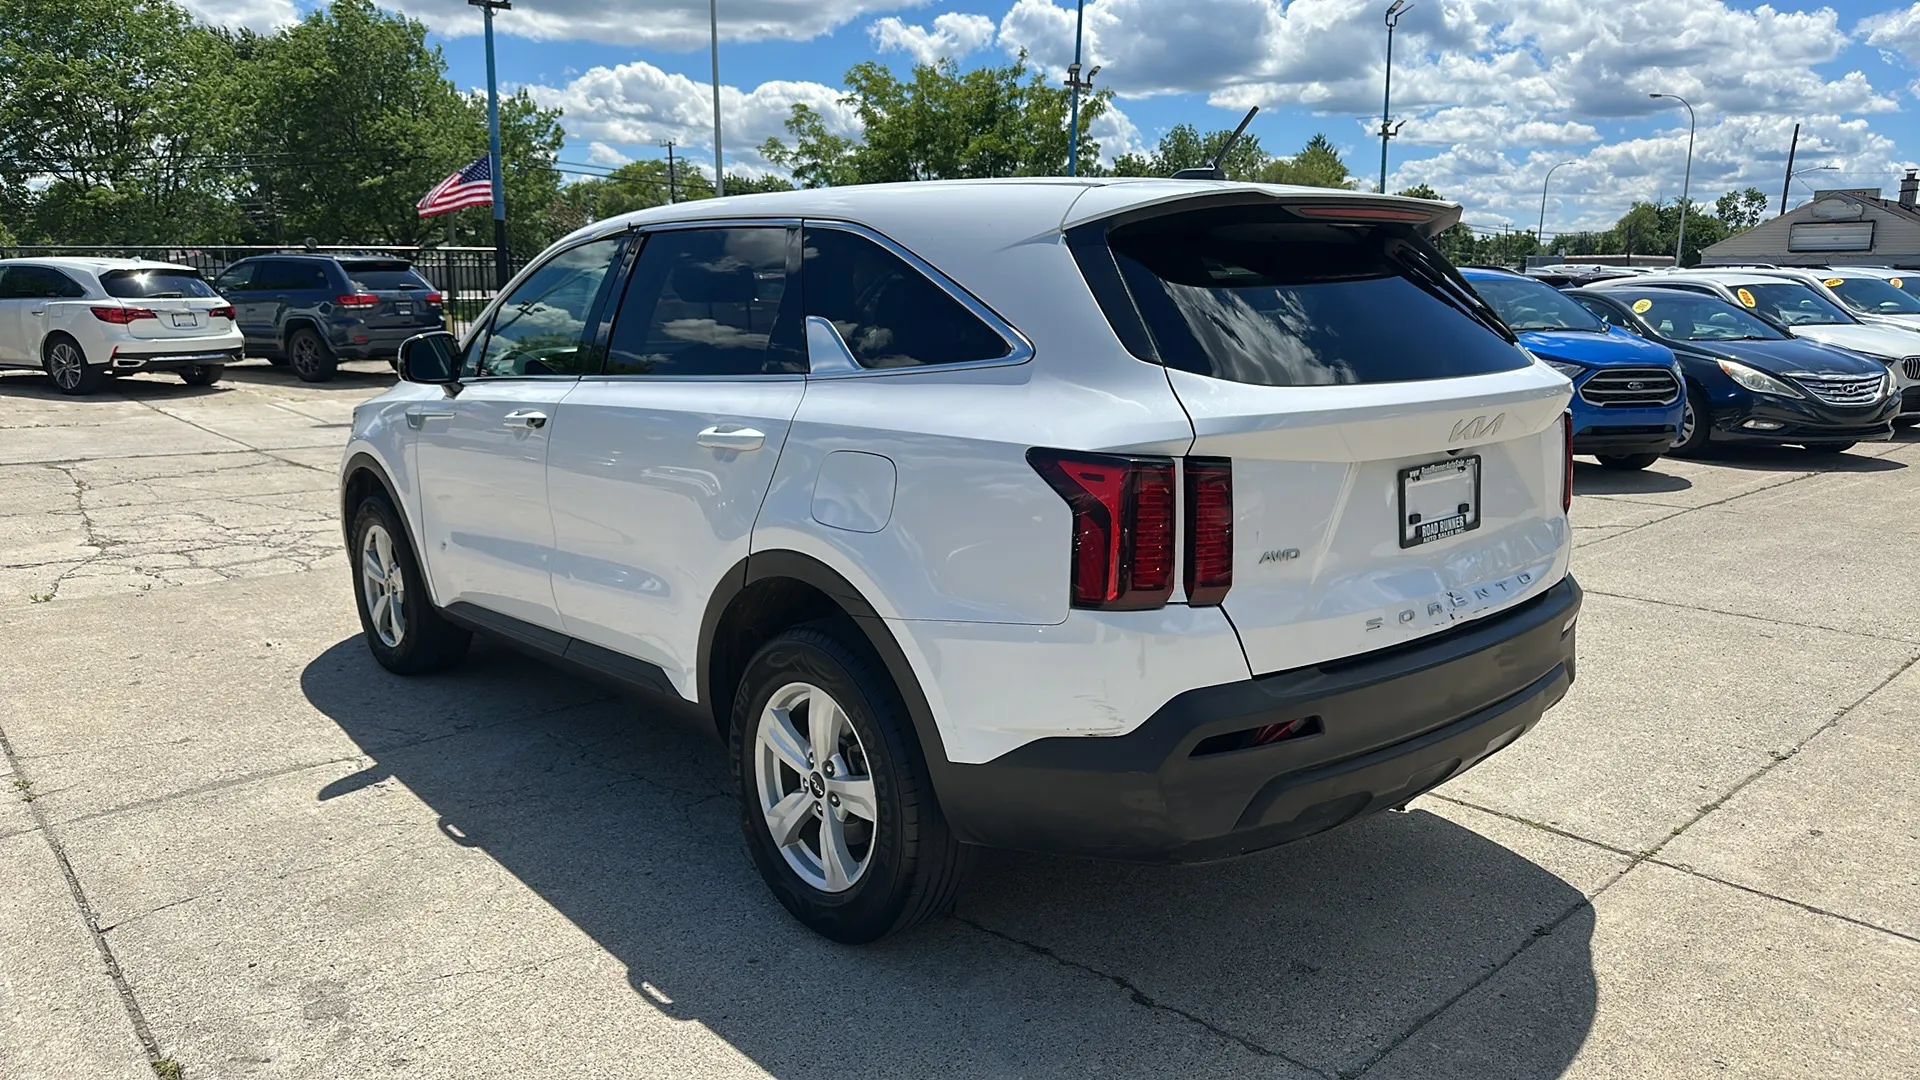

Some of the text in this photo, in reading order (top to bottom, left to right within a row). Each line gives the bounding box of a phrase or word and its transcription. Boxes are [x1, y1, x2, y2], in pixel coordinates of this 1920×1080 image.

[1421, 515, 1464, 538] ROAD RUNNER
[1422, 535, 1437, 544] AUTO
[1438, 530, 1454, 540] SALES
[1258, 548, 1301, 564] AWD
[1365, 572, 1532, 632] SORENTO
